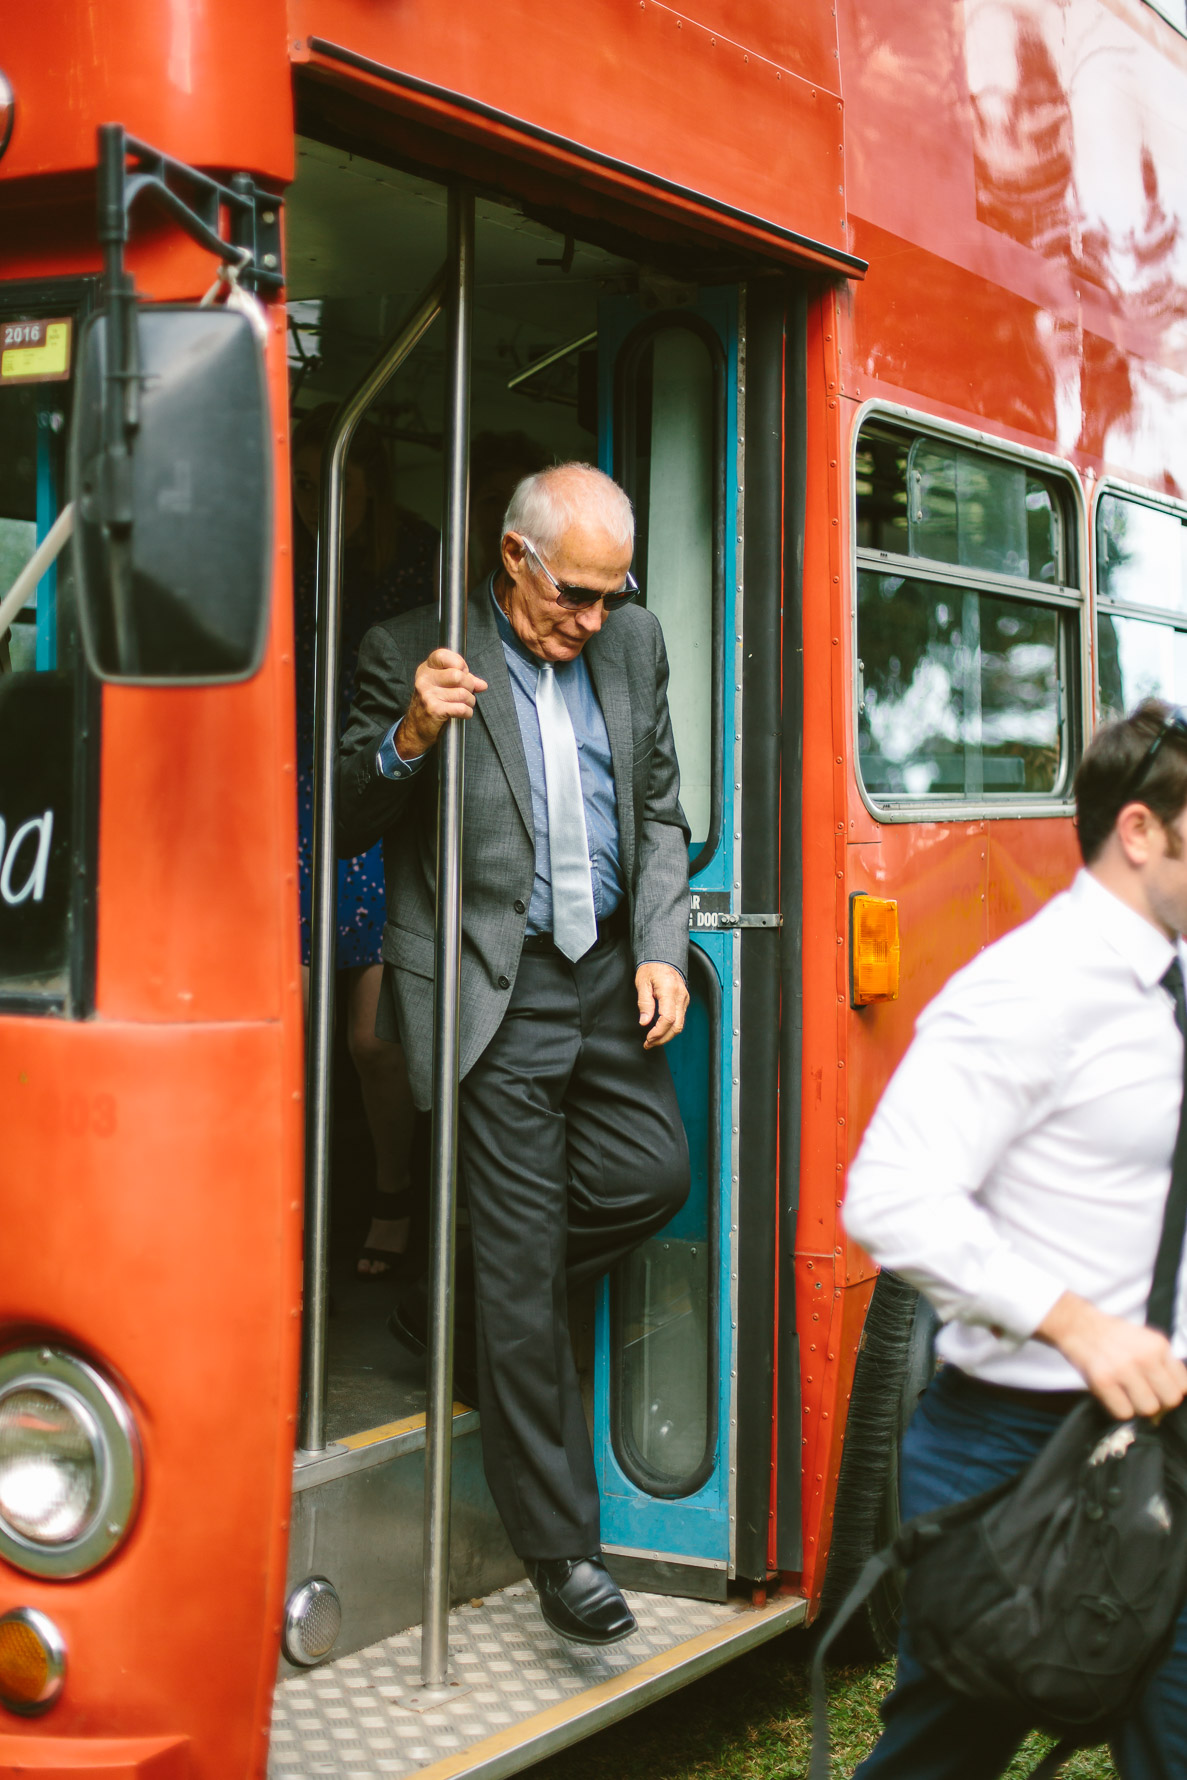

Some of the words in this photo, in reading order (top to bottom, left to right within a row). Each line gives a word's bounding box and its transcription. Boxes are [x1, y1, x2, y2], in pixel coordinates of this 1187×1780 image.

[5, 326, 39, 343] 2016
[0, 809, 53, 904] a
[697, 912, 724, 927] DOO
